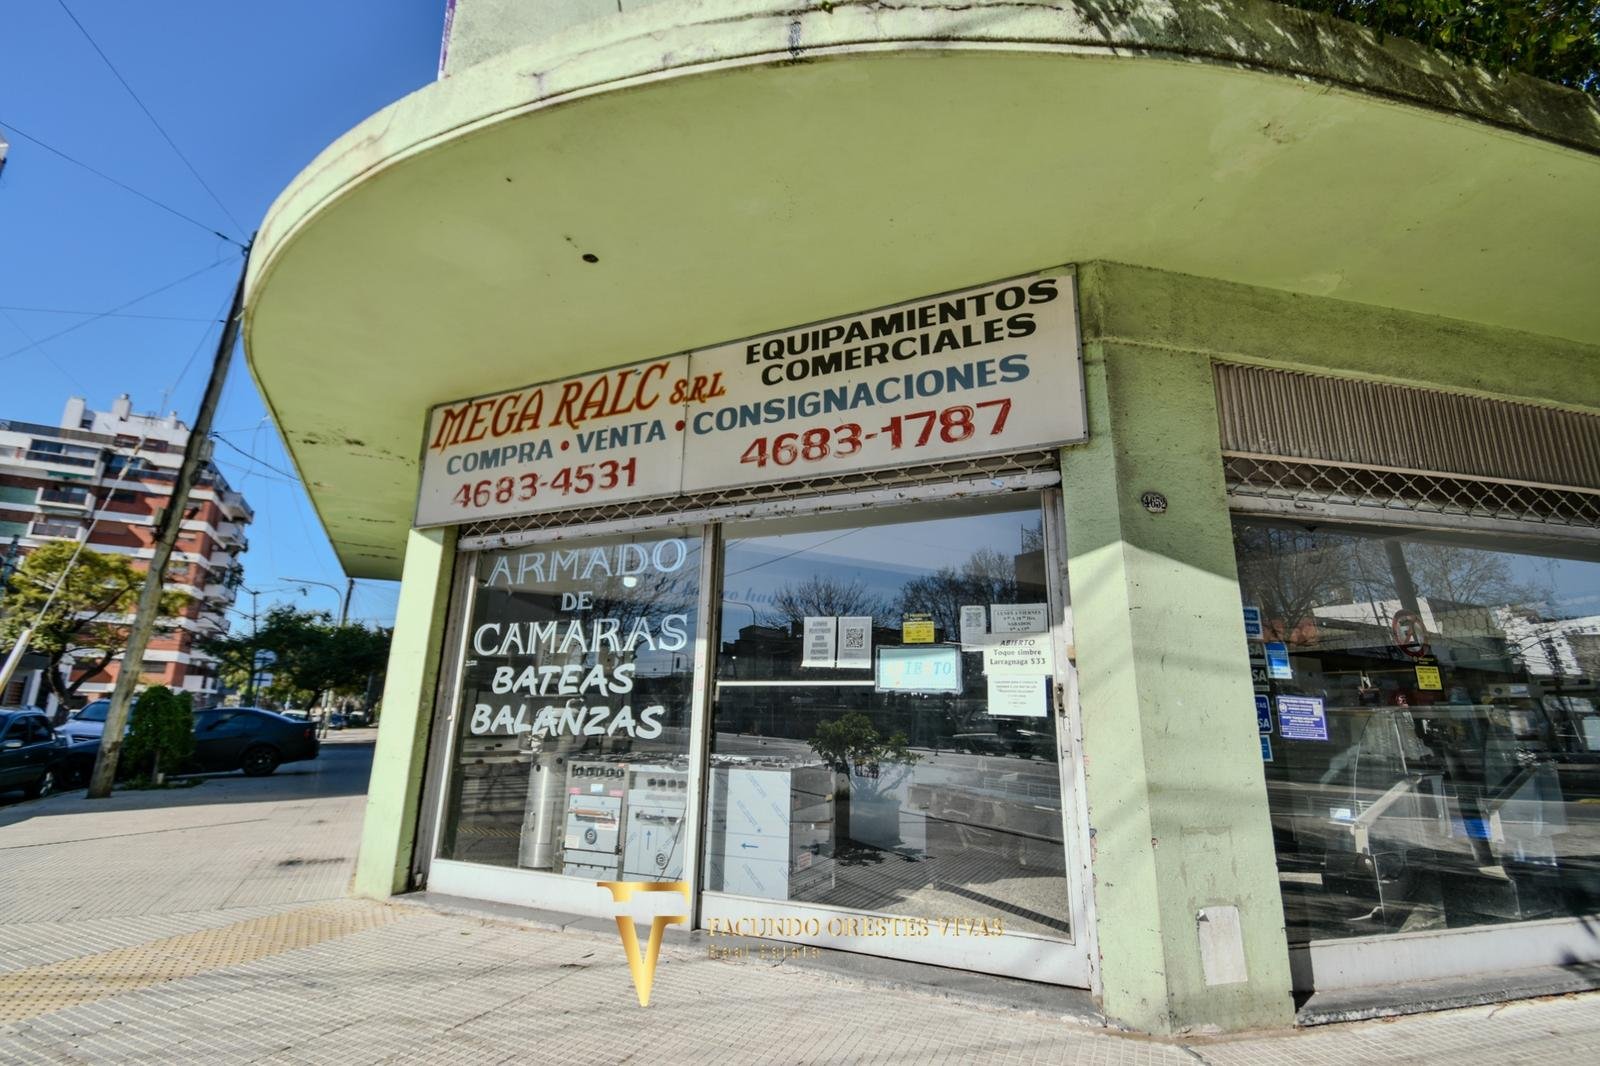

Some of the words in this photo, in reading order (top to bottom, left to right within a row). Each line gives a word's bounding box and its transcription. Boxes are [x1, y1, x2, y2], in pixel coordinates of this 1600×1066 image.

[746, 279, 1058, 365] EQUIPAMIENTOS
[761, 312, 1036, 386] COMERCIALES
[431, 388, 544, 453] MEGA
[549, 361, 670, 429] RALC
[446, 439, 553, 475] COMPRA
[576, 420, 666, 453] VENTA
[693, 354, 1030, 435] CONSIGNACIONES
[740, 398, 1012, 468] 4683-1787
[451, 457, 637, 508] 4683-4531
[485, 538, 688, 587] ARMADO
[561, 591, 593, 611] DE
[474, 614, 689, 656] CAMARAS
[993, 648, 1015, 657] Toque
[1017, 648, 1042, 656] timbre
[1000, 639, 1036, 647] ABIERTO
[491, 663, 636, 697] BATEAS
[470, 704, 665, 740] BALANZAS
